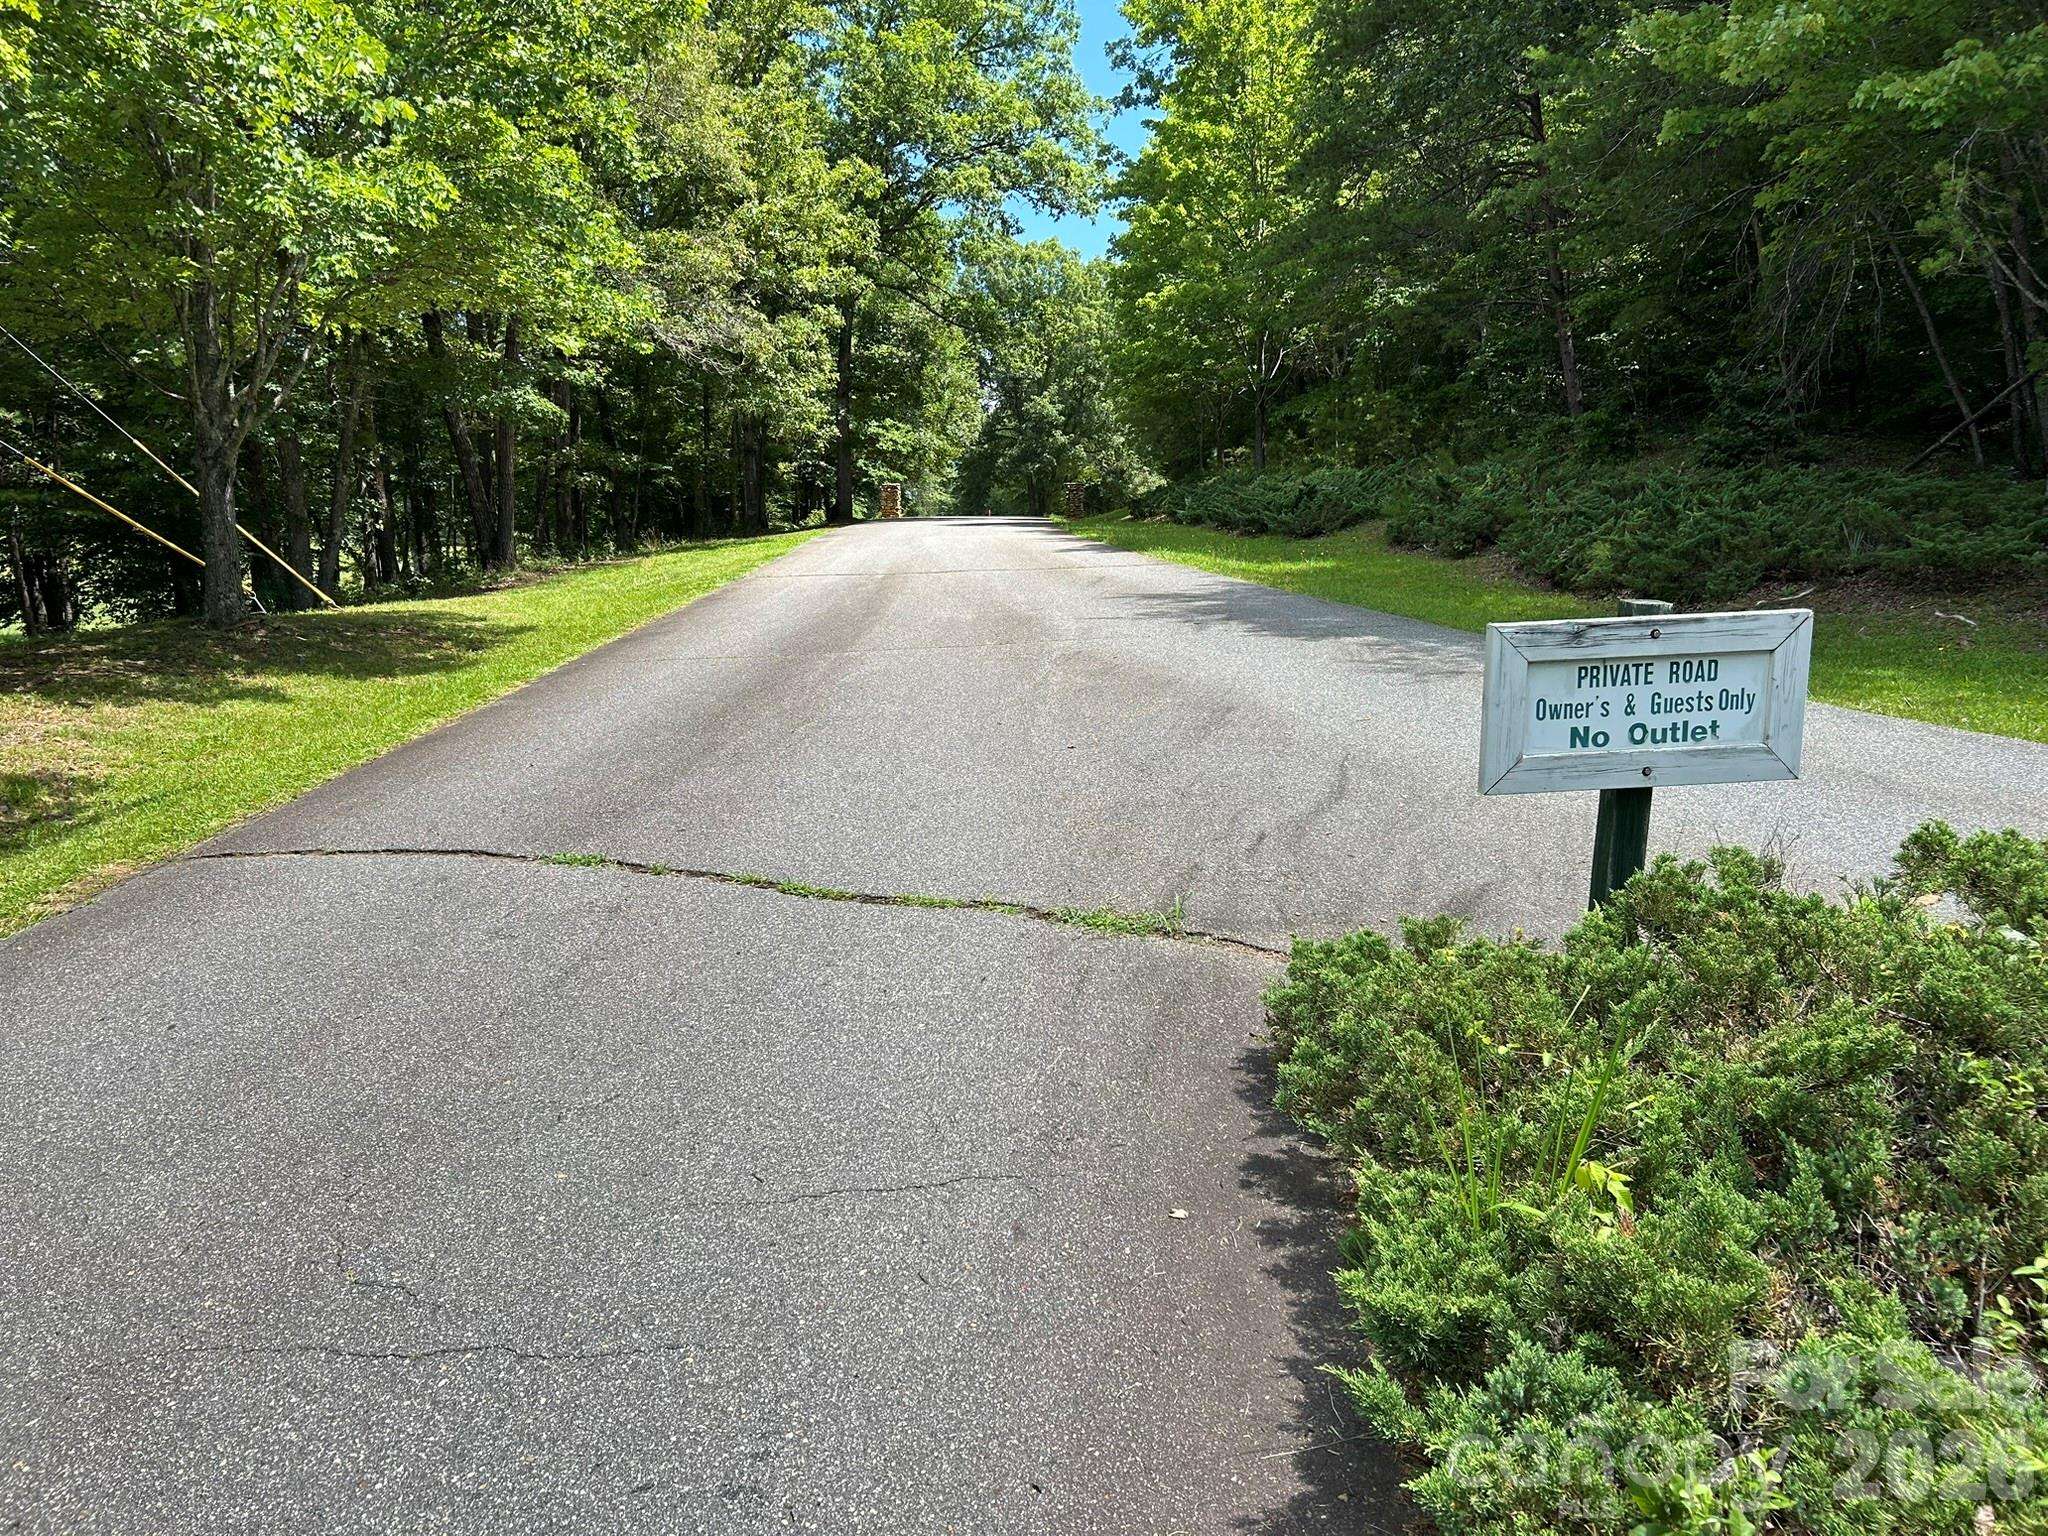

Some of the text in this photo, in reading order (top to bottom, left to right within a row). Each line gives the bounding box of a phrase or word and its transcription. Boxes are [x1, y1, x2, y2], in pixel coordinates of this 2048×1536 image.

[1577, 659, 1719, 689] PRIVATE ROAD
[1535, 688, 1756, 721] Owner's & Guests Only
[1569, 719, 1720, 749] No Outlet
